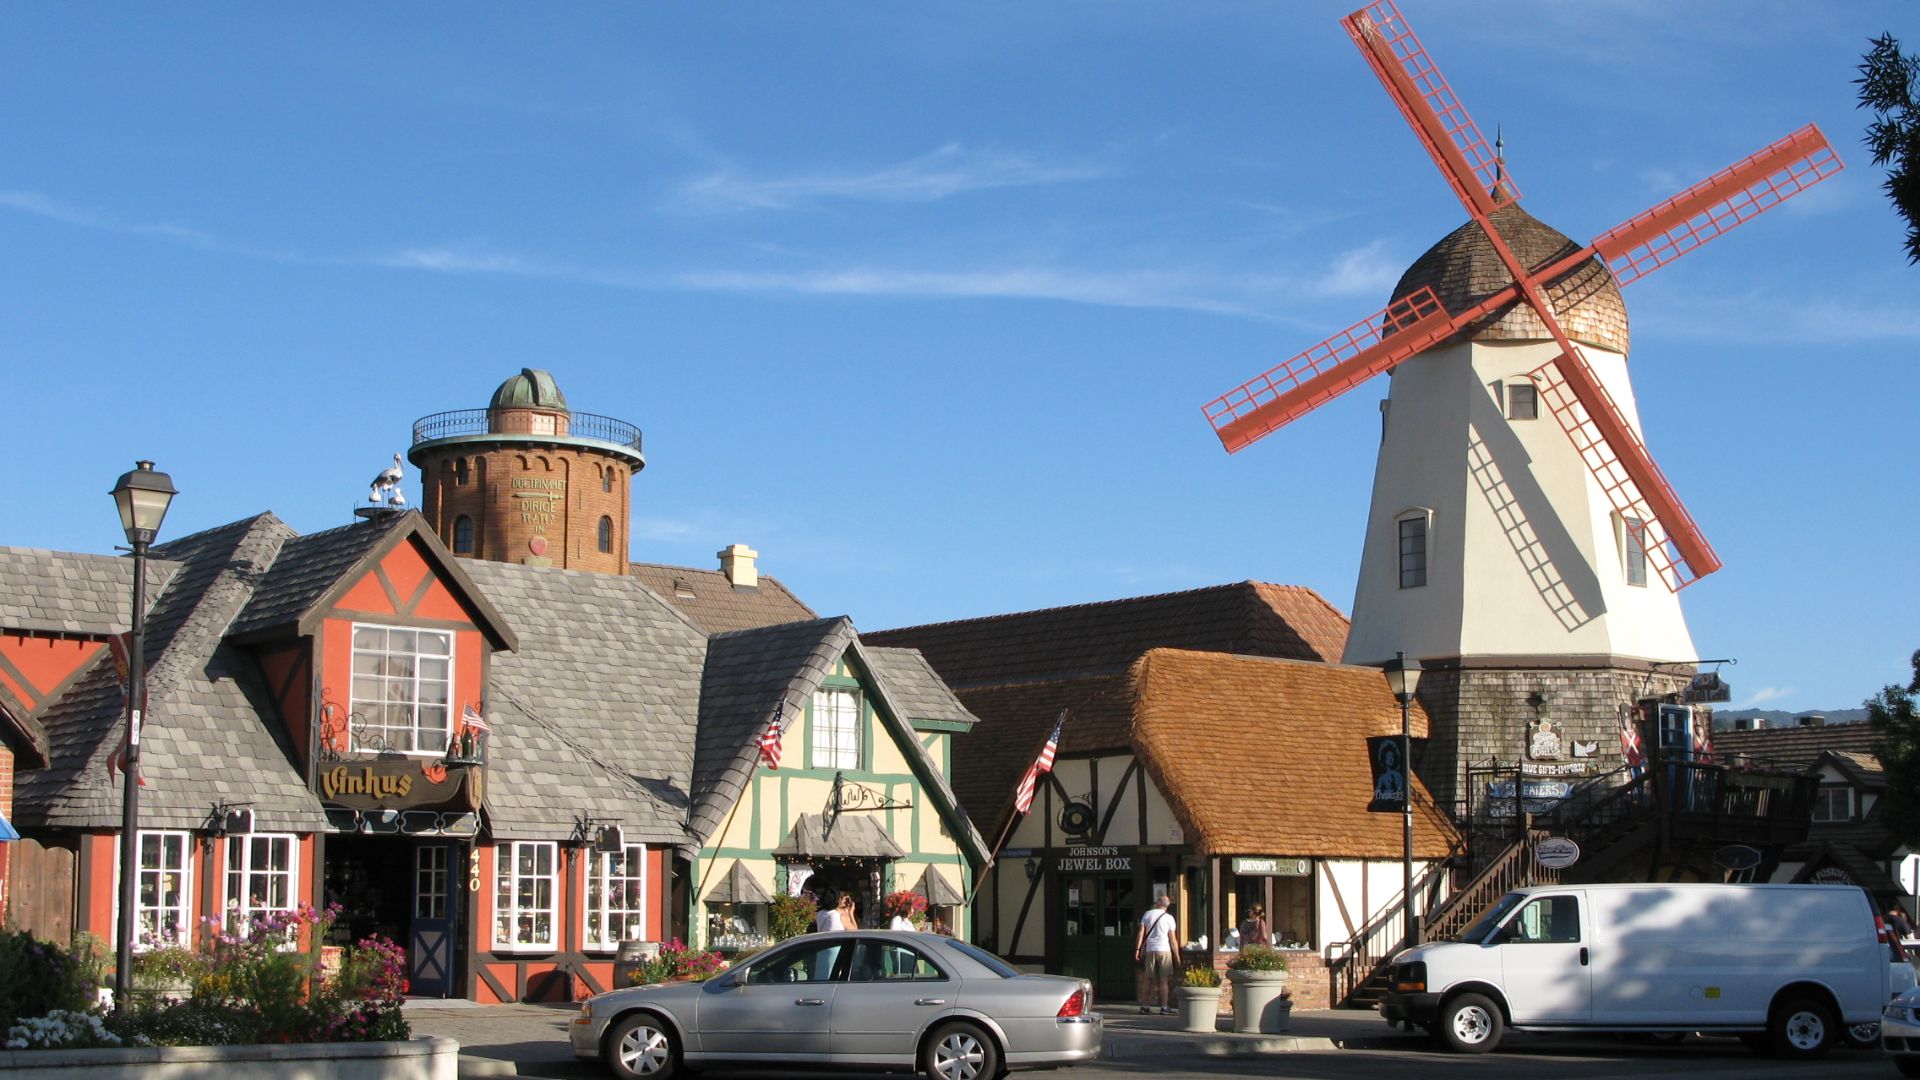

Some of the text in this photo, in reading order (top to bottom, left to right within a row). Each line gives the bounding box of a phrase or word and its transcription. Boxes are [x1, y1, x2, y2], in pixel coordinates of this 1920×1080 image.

[521, 500, 557, 513] DIRIGE
[535, 525, 545, 533] IN
[322, 766, 414, 799] Vinhus
[1069, 847, 1118, 857] JOHNSON'S
[469, 849, 481, 892] 440
[1058, 858, 1131, 871] JEWEL BOX
[1239, 860, 1277, 873] JOHNSON'S
